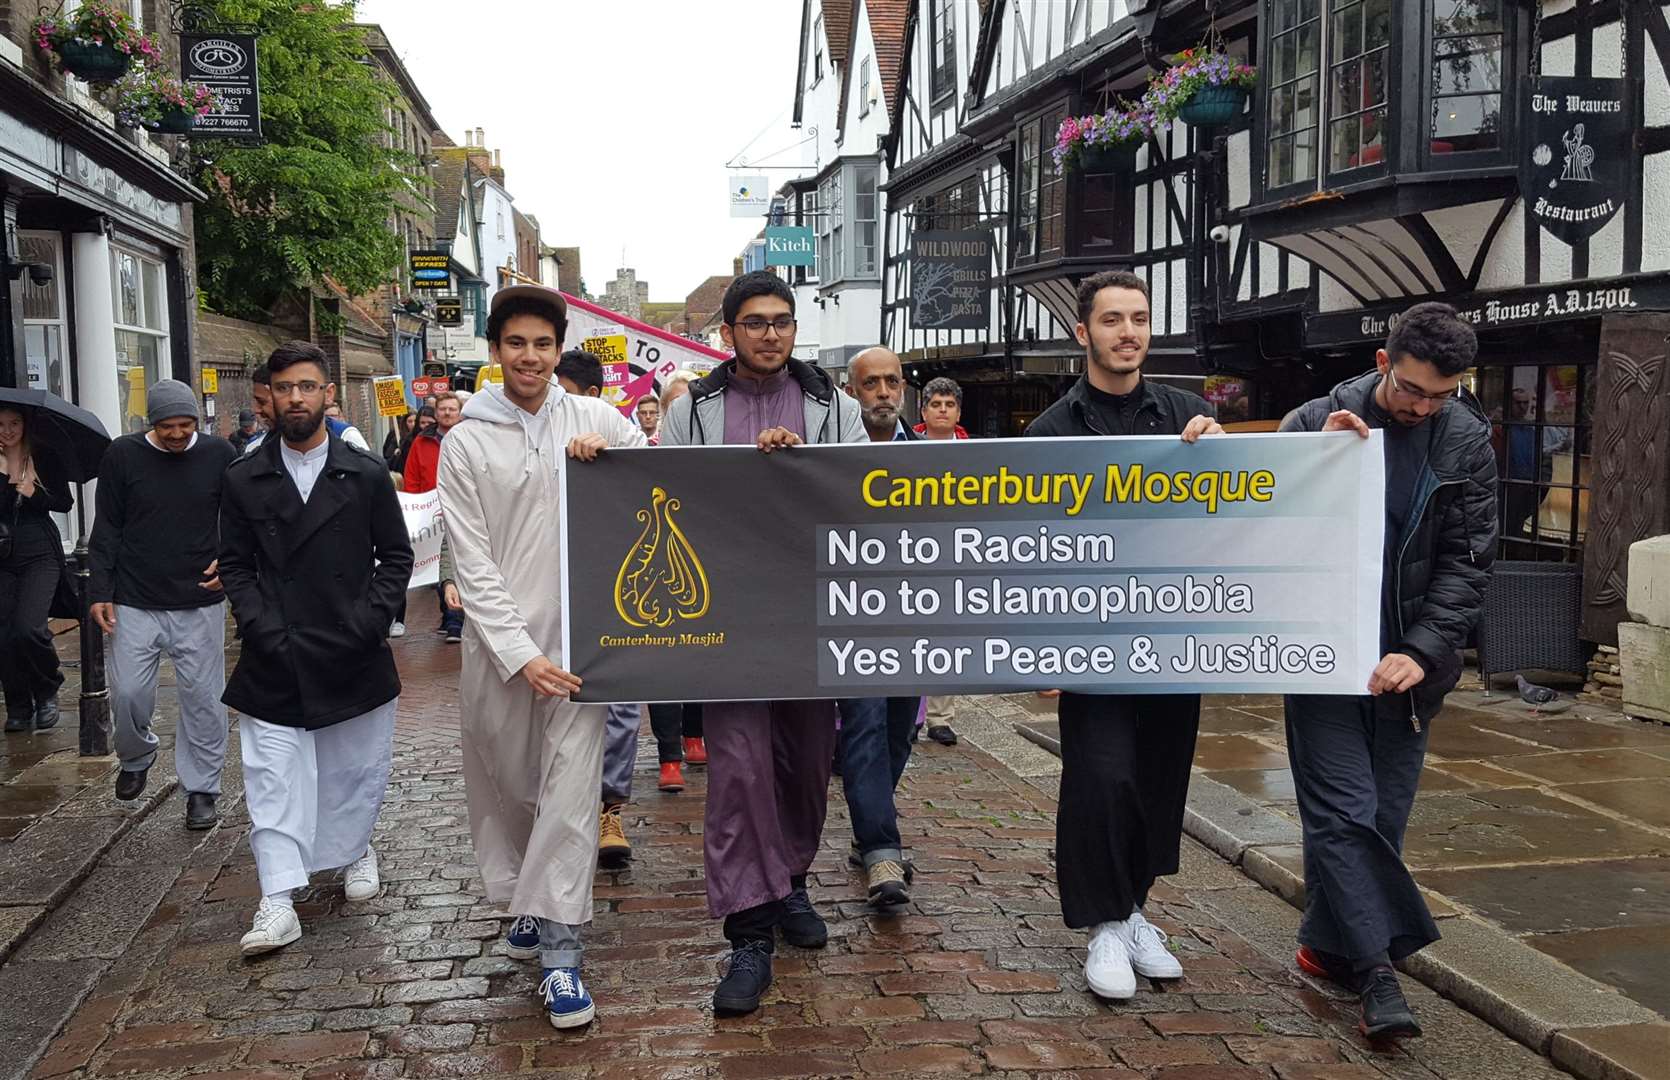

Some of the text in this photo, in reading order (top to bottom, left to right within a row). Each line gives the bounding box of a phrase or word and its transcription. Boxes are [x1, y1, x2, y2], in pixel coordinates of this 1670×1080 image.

[194, 40, 240, 52] CARGILLS
[207, 87, 252, 95] OMETRISTS
[1532, 94, 1621, 115] The Weavers
[1533, 196, 1615, 222] Restaurant
[769, 237, 811, 252] Kitch
[916, 240, 987, 257] WILDWOOD
[952, 286, 980, 298] PIZZA
[951, 303, 982, 315] PASTA
[1361, 315, 1385, 337] The
[1485, 299, 1540, 325] House
[586, 337, 608, 347] STOP
[598, 353, 624, 363] TACKS
[635, 339, 661, 363] TO
[603, 373, 622, 382] IGHT
[861, 463, 1276, 517] Canterbury Mosque
[827, 525, 1116, 566] No to Racism
[415, 554, 441, 568] comm
[827, 574, 1254, 624] No to Islamophobia
[600, 632, 725, 648] Canterbury Masjid
[827, 634, 1336, 676] Yes for Peace & Justice
